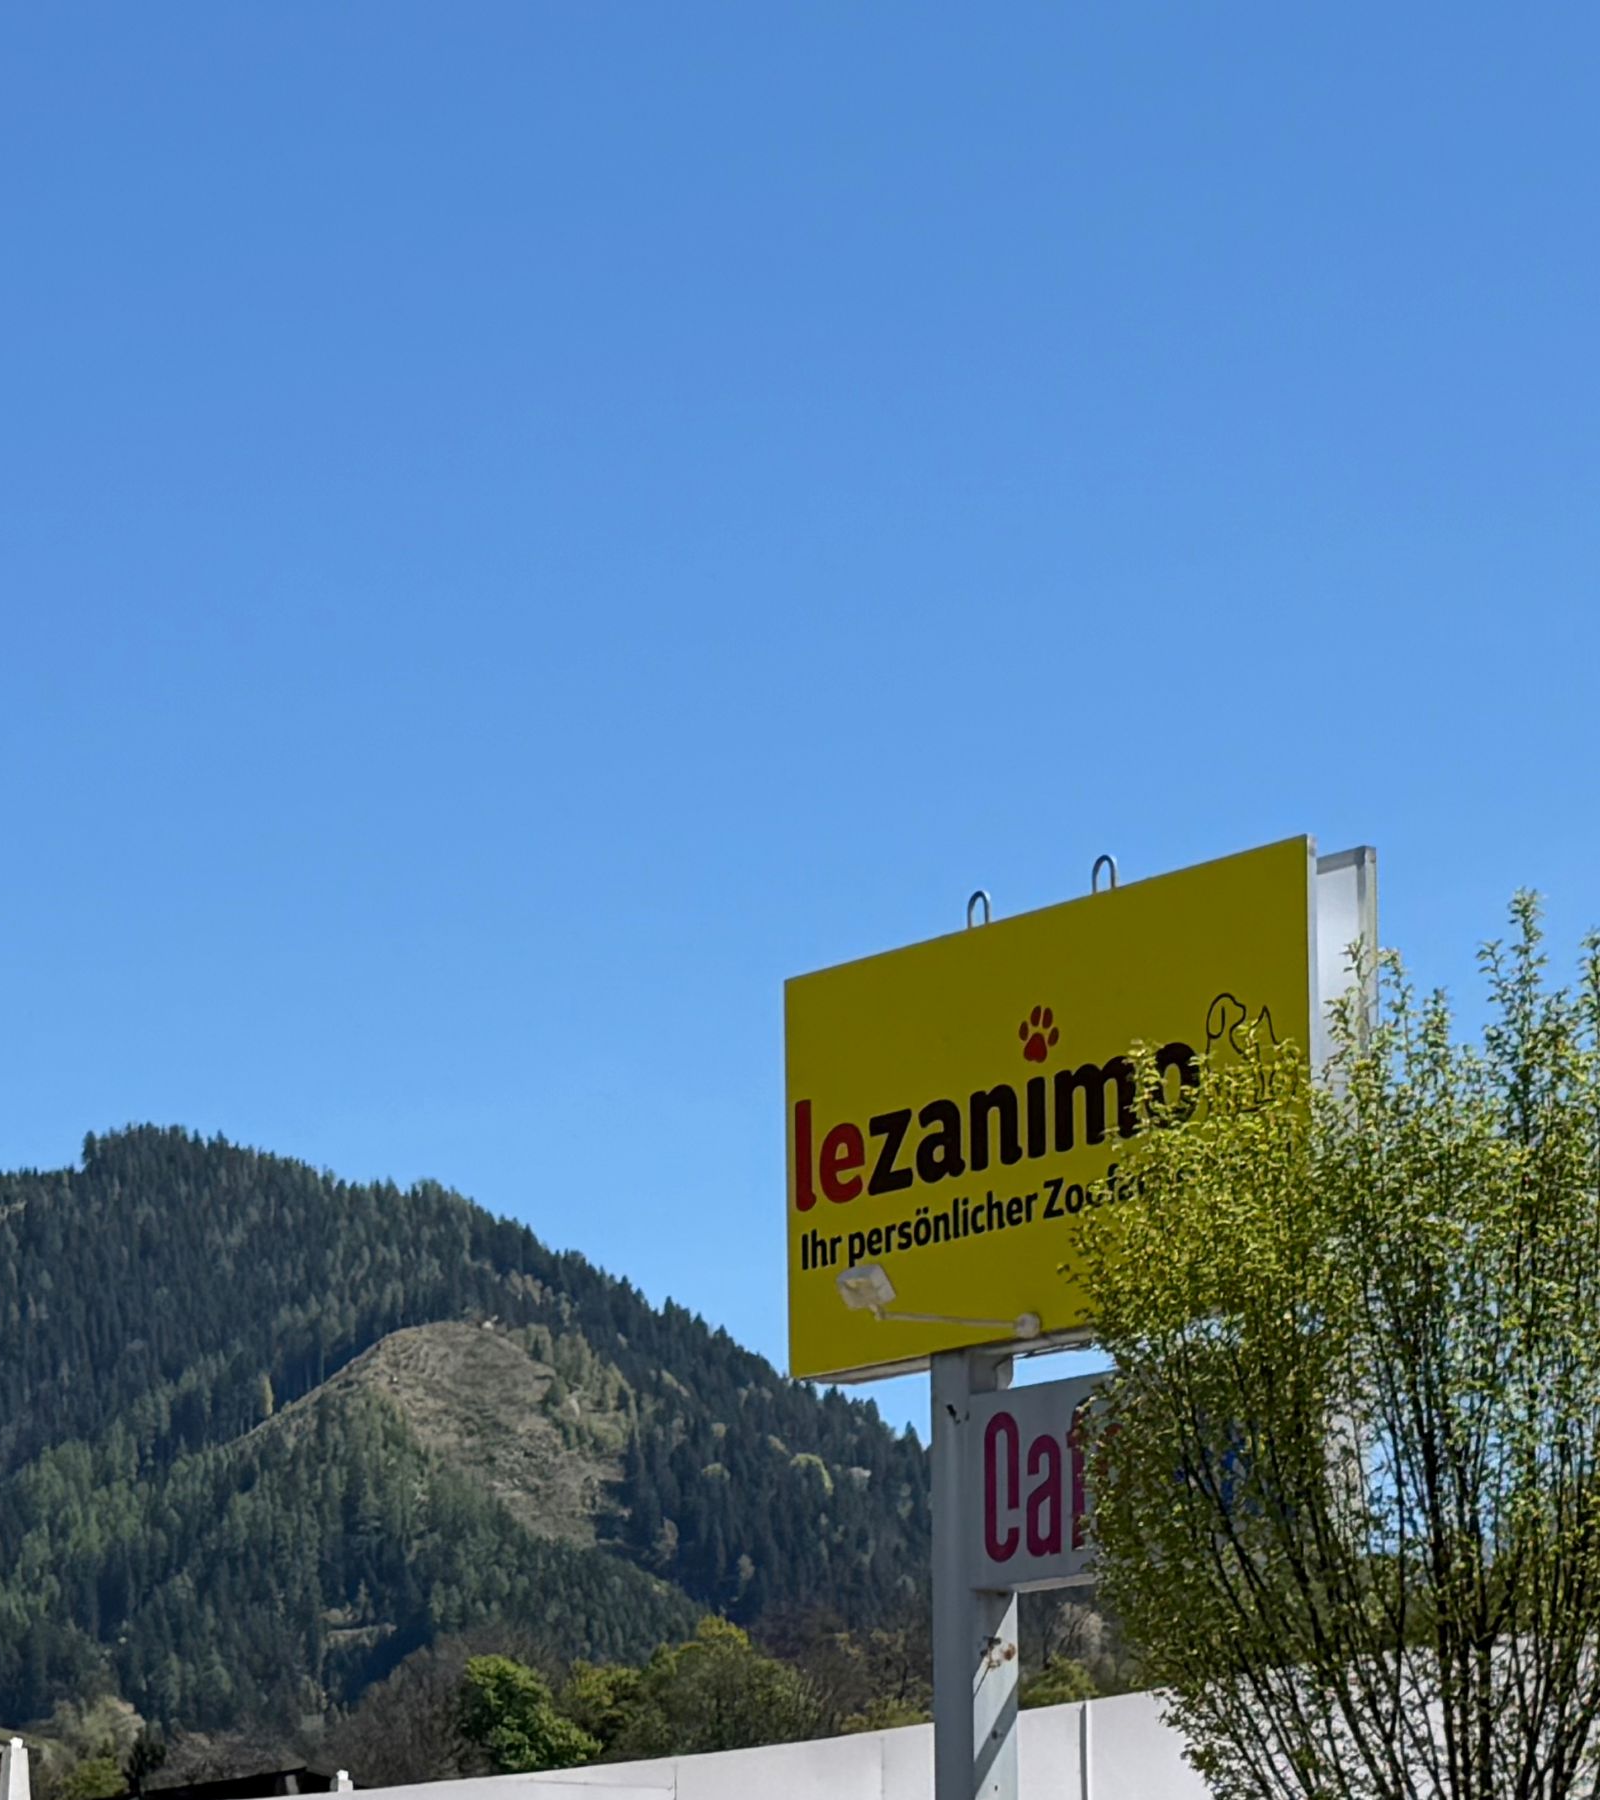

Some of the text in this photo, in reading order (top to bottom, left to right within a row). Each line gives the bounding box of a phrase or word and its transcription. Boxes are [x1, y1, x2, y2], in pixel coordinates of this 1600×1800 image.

[794, 1041, 1200, 1212] lezanimo
[801, 1228, 842, 1270] Ihr
[847, 1190, 1039, 1267] persönlicher
[984, 1396, 1124, 1563] Caf
